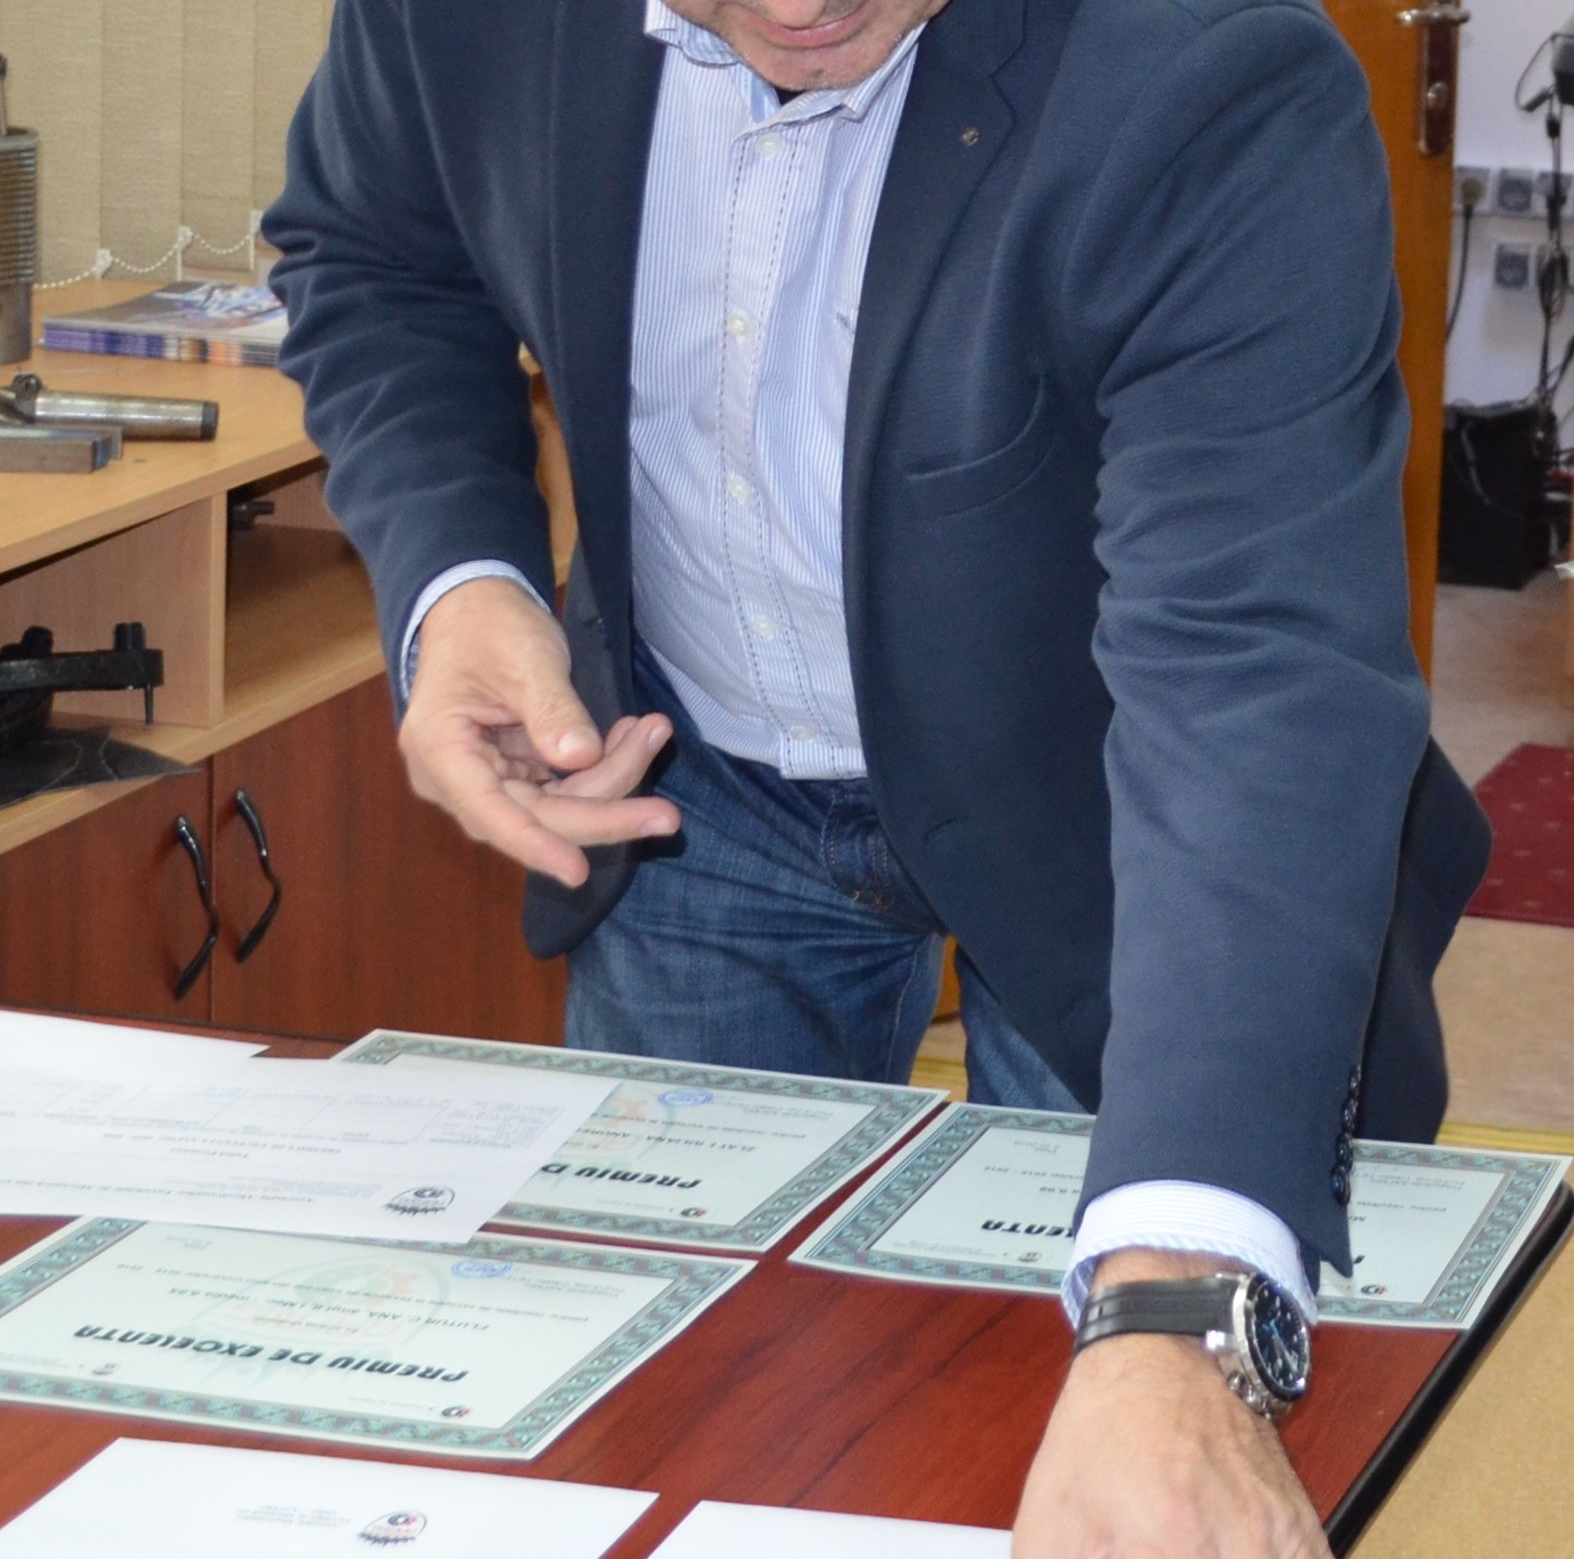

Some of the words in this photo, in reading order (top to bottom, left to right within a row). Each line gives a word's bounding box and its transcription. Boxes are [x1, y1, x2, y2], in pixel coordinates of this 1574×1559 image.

[540, 1162, 571, 1174] D
[574, 1165, 703, 1189] PREMIU
[73, 1324, 265, 1359] EXCELENTA
[267, 1348, 324, 1366] DE
[326, 1355, 470, 1383] PREMIU
